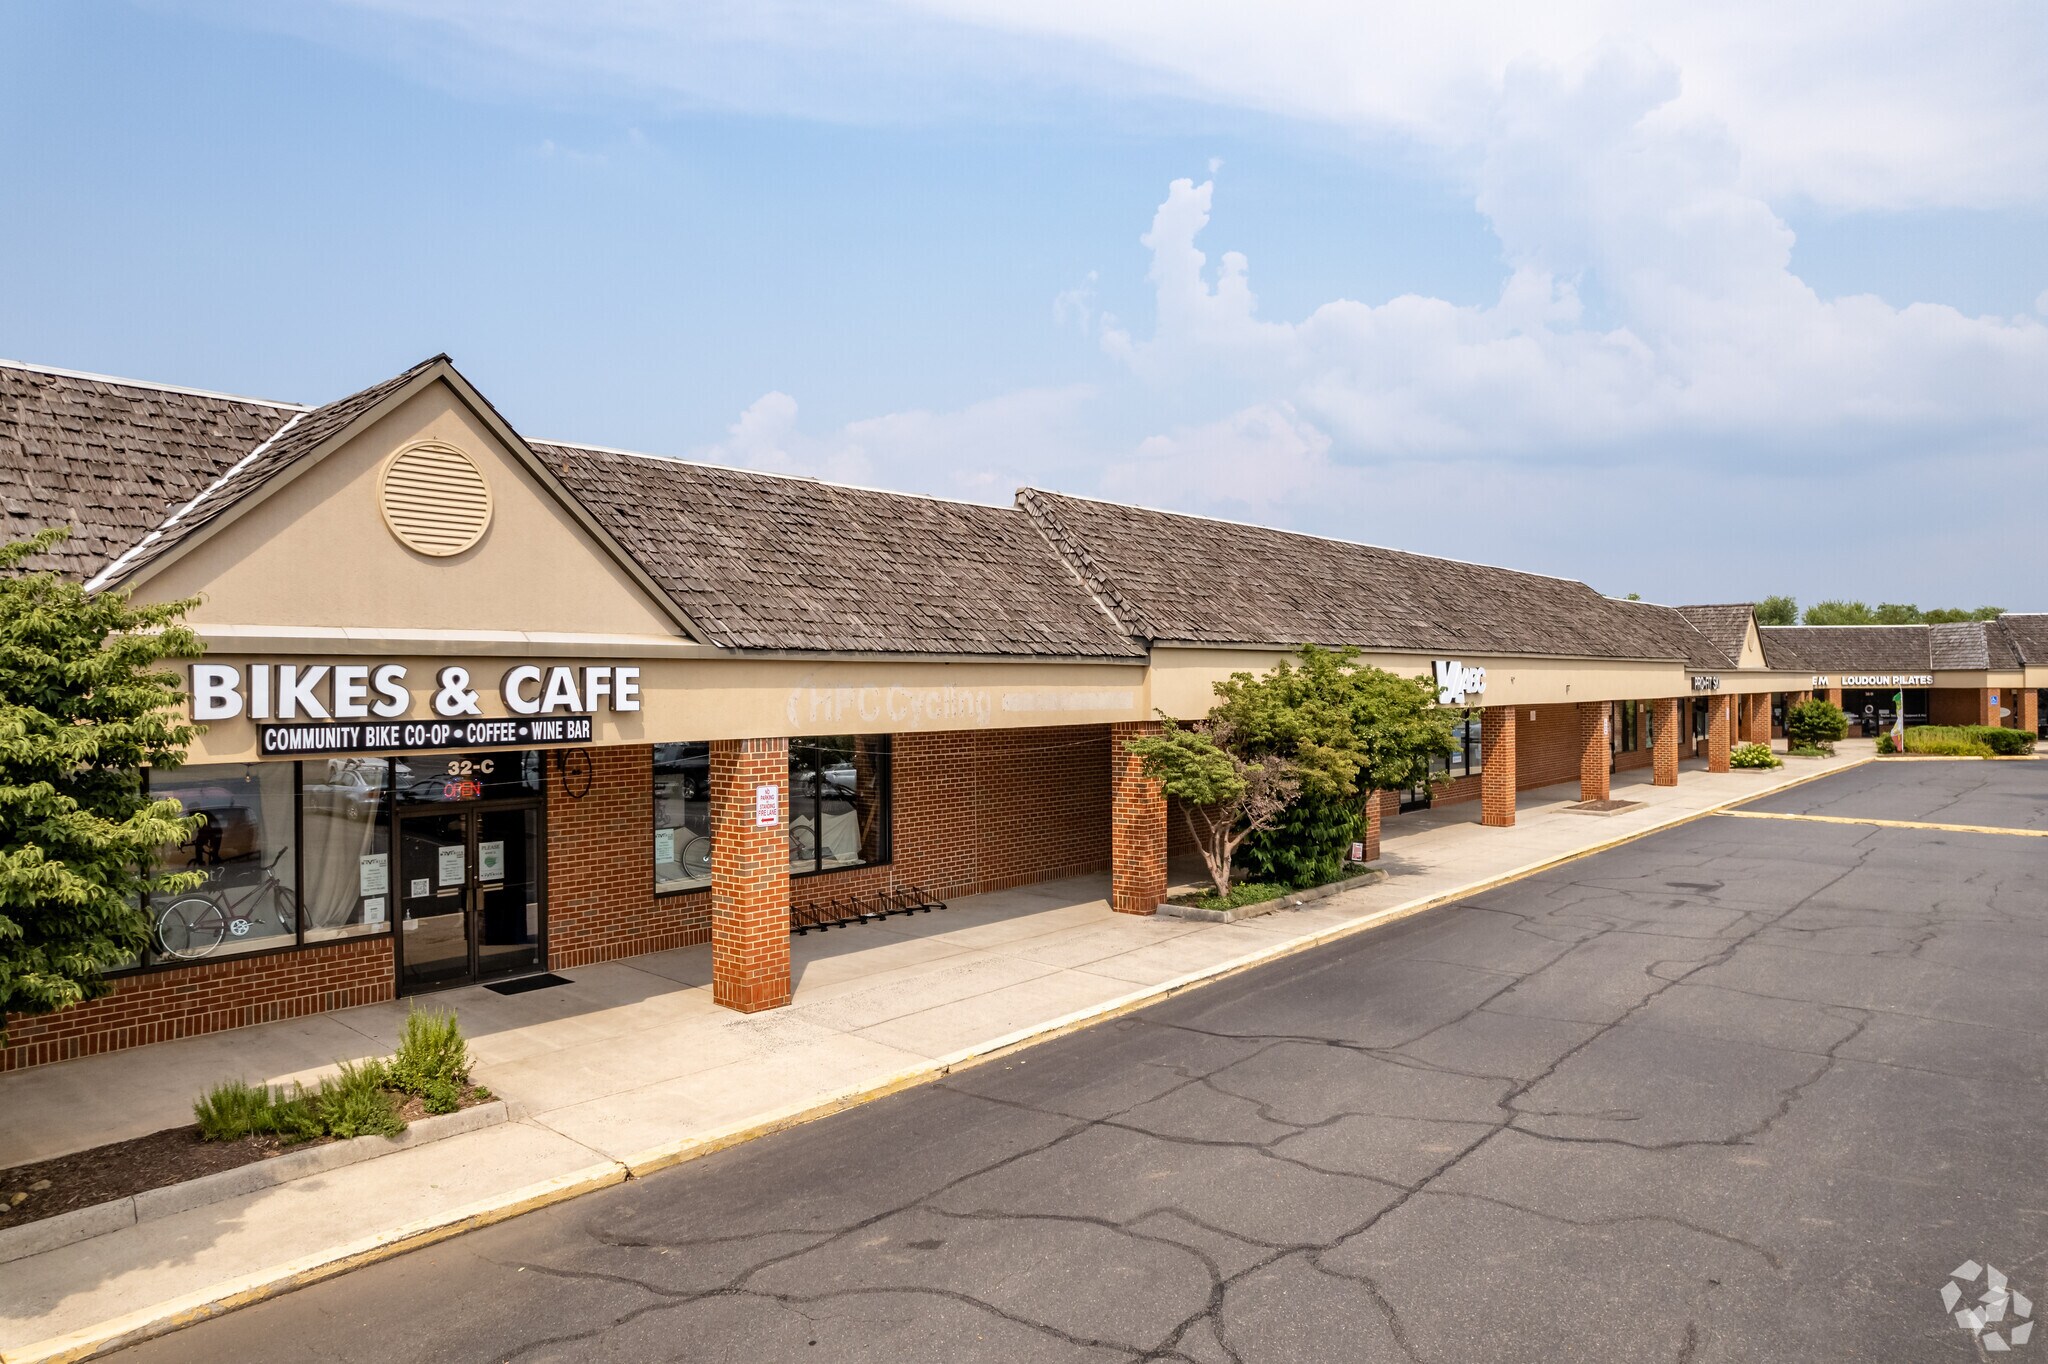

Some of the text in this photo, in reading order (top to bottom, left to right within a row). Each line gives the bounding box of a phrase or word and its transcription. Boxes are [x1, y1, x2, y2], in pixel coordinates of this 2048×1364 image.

[1842, 675, 1934, 686] LOUDOUN PILATES
[191, 664, 640, 720] BIKES & CAFE
[264, 719, 590, 751] COMMUNITY BIKE CO-OP COFFEE WINE BAR
[448, 759, 494, 776] 32-C
[444, 781, 481, 798] OPEN
